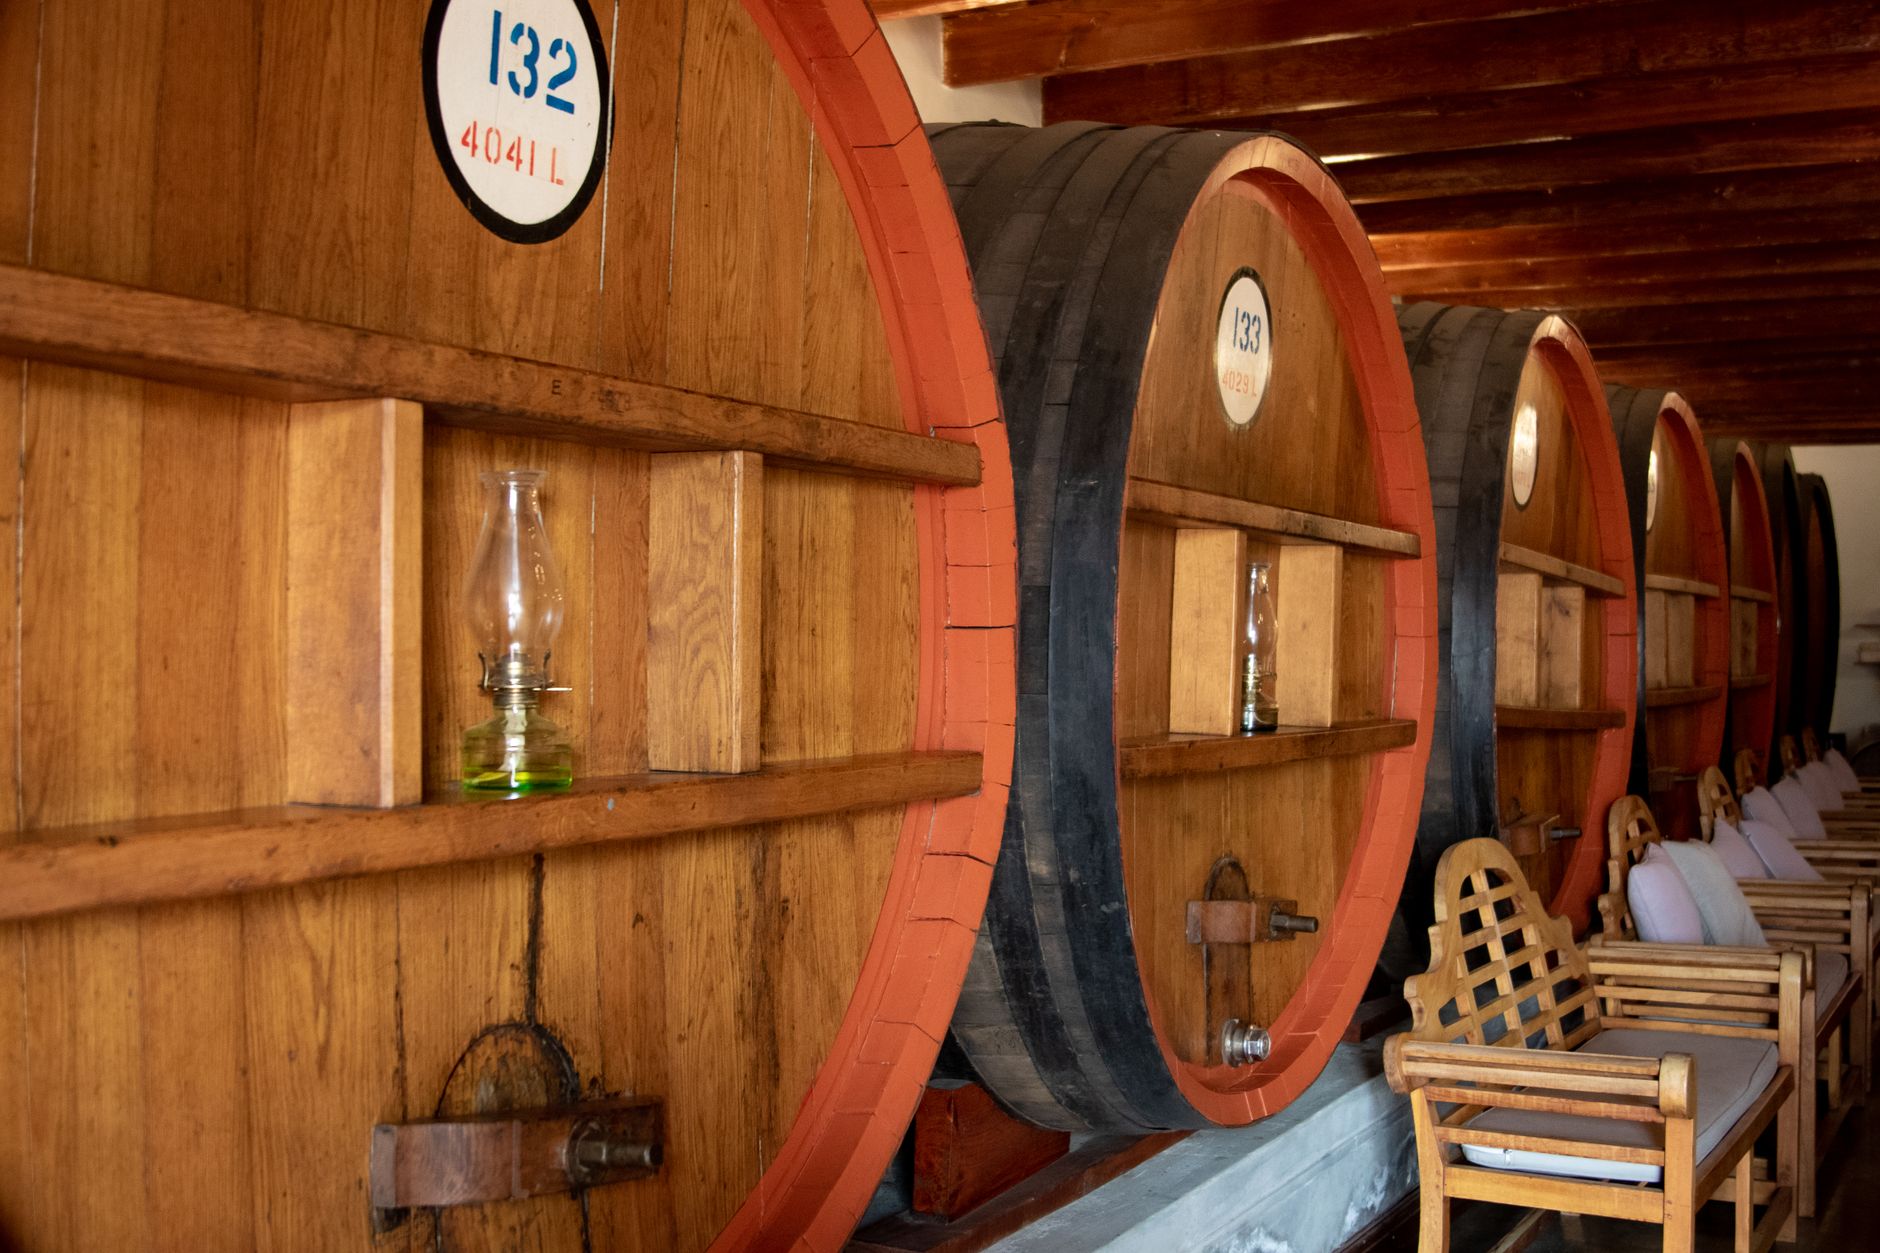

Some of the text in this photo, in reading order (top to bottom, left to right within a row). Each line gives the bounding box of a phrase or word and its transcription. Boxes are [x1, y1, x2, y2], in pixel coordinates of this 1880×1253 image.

[489, 9, 577, 114] 132
[461, 120, 564, 186] 4041 L
[1233, 306, 1261, 355] 133
[1222, 369, 1249, 394] 4029
